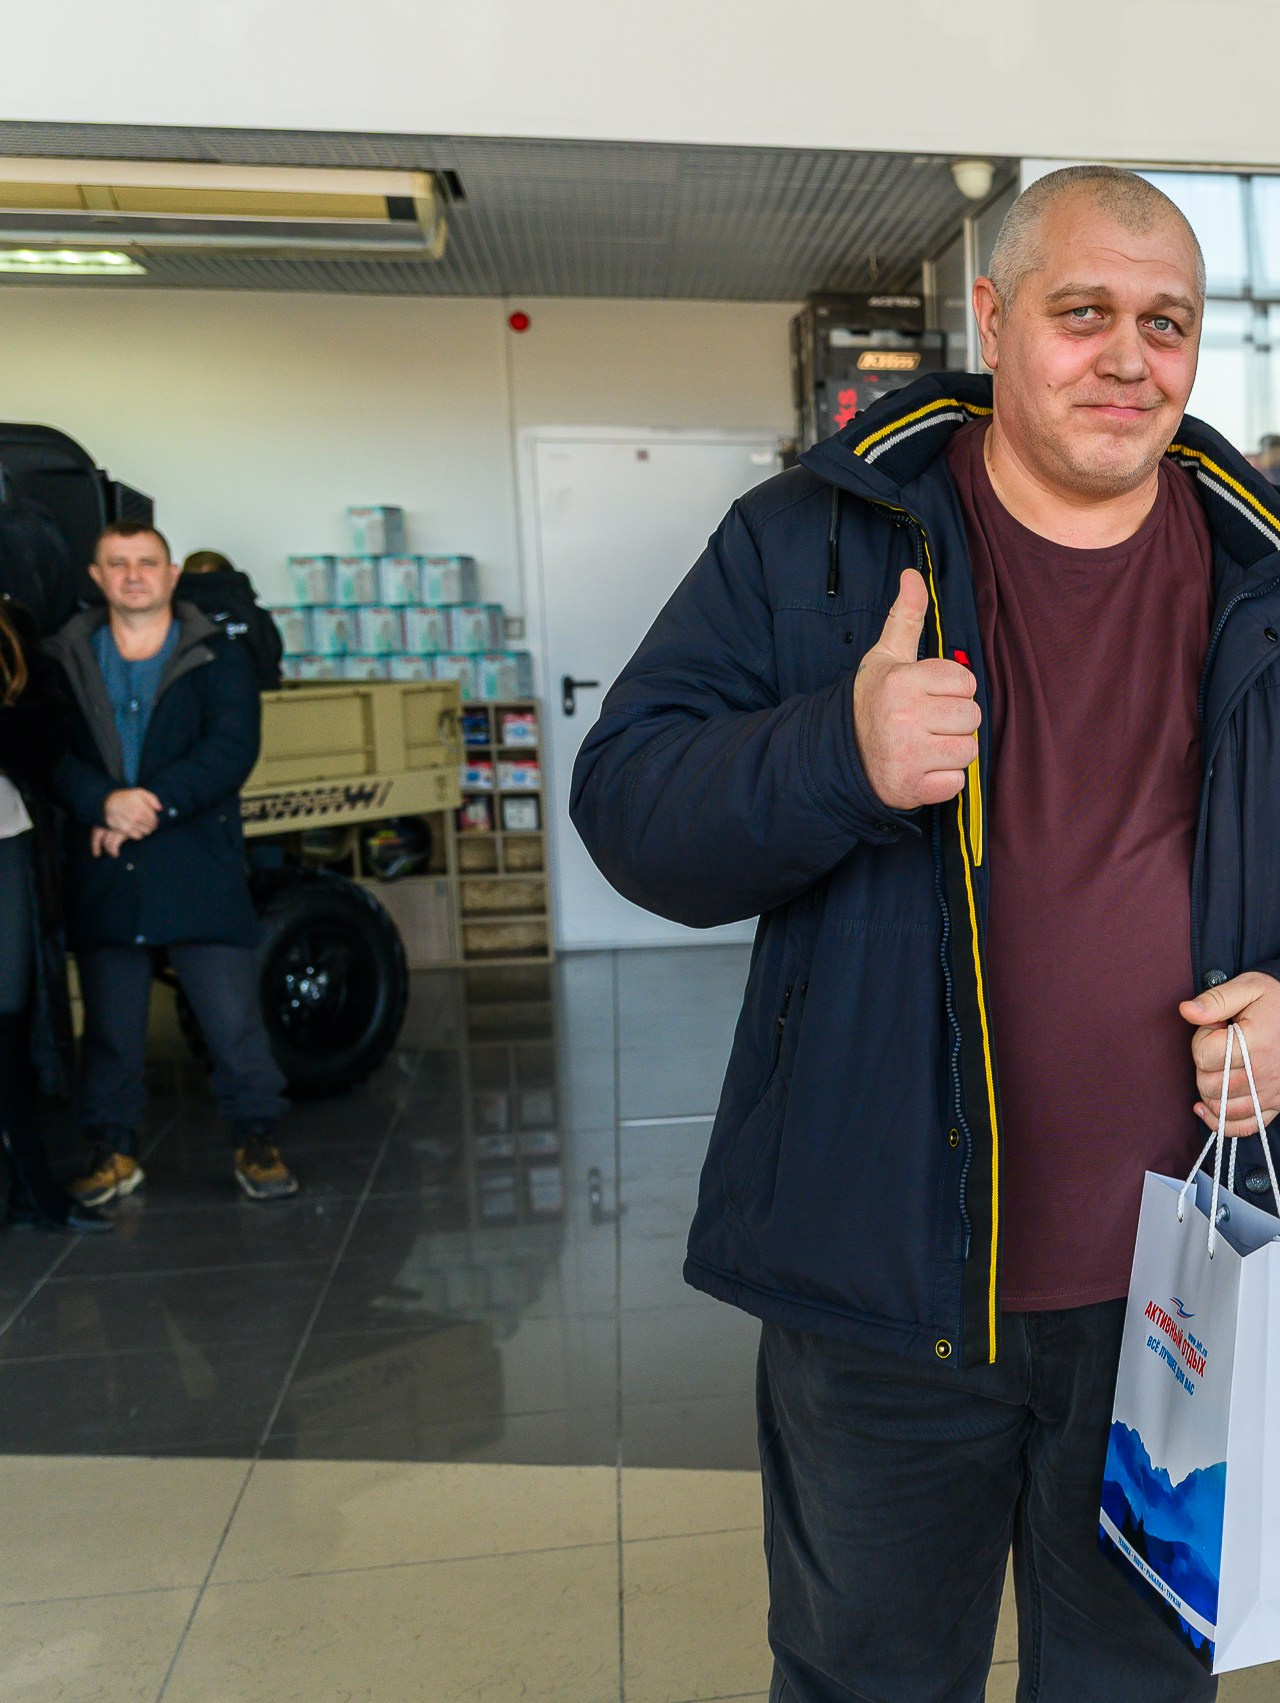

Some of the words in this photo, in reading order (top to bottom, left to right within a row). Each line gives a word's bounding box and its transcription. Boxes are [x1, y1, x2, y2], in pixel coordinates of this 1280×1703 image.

[1144, 1300, 1184, 1351] АКТИВНЫЙ
[1181, 1338, 1207, 1378] ОТДЫХ
[1146, 1334, 1161, 1353] ВСЁ
[1159, 1345, 1178, 1374] ЛУЧШЕЕ
[1175, 1366, 1185, 1386] ДЛЯ
[1183, 1376, 1195, 1396] ВАС
